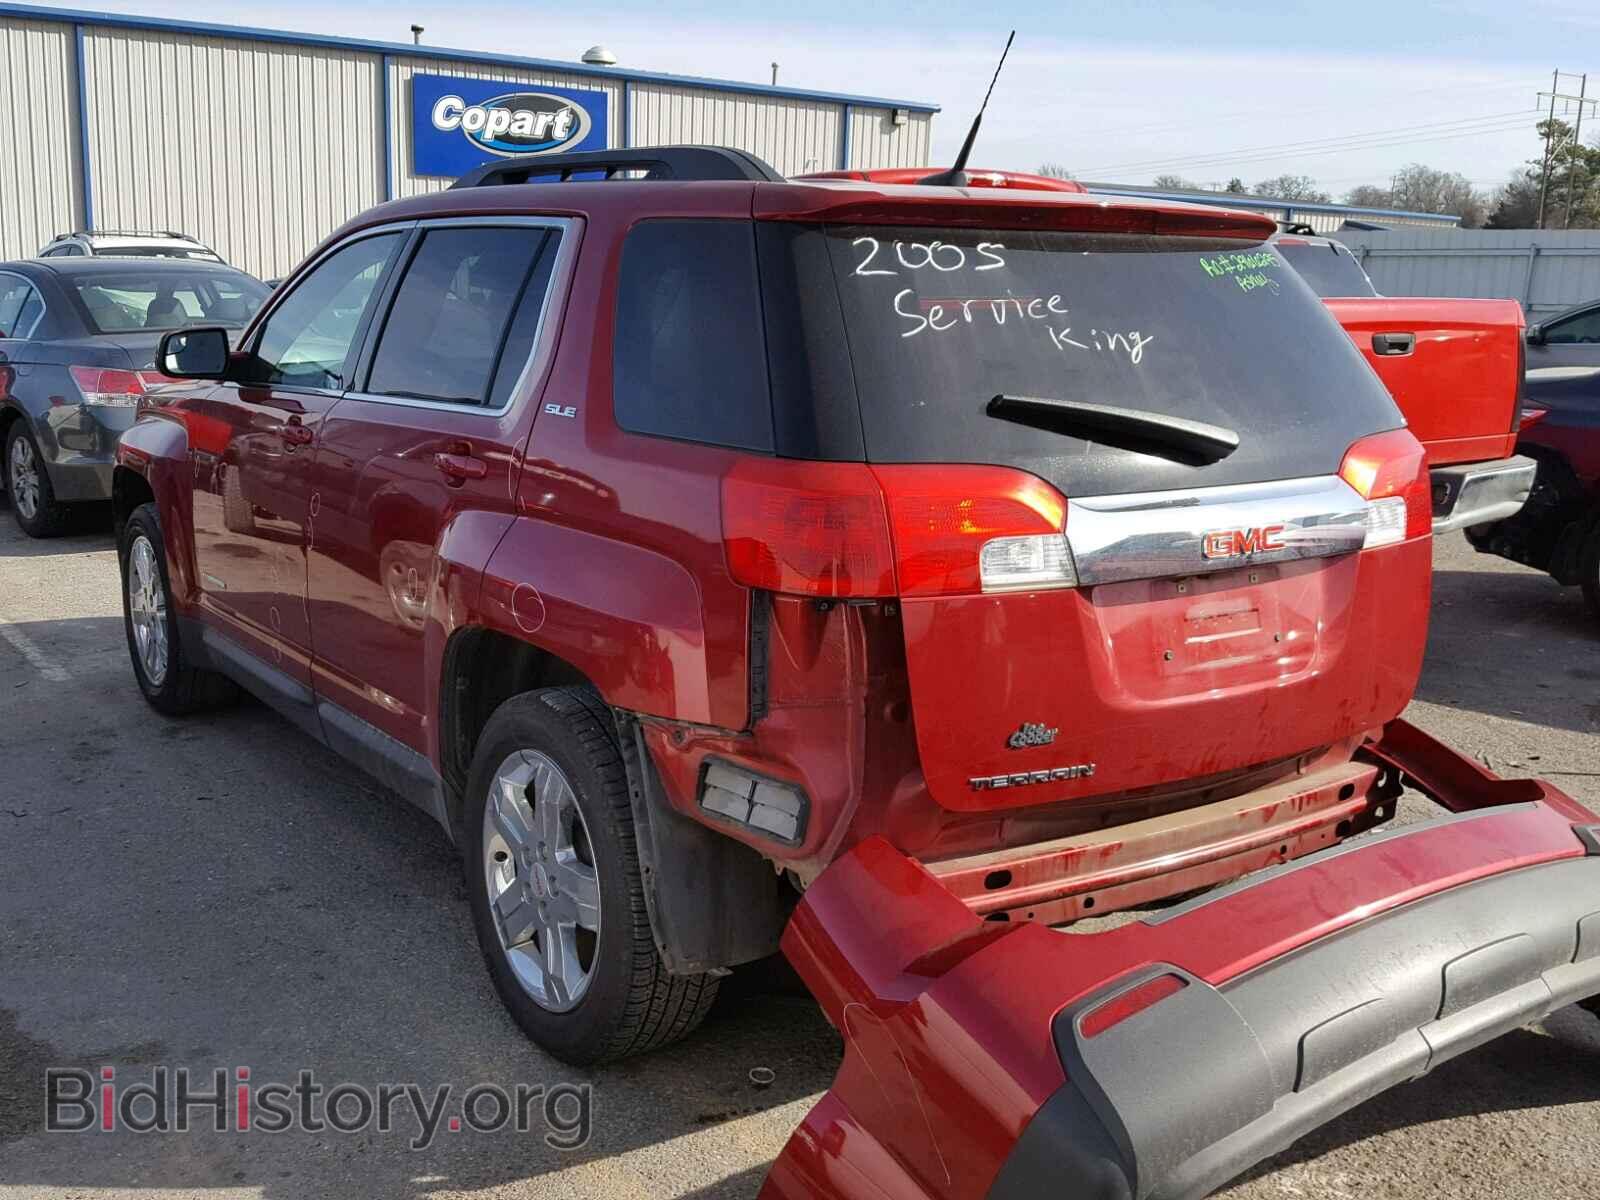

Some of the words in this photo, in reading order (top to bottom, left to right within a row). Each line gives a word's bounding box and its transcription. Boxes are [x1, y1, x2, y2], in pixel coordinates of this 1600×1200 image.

[432, 95, 573, 141] Copart
[894, 289, 1069, 338] Service
[1047, 326, 1154, 364] King
[544, 403, 577, 418] SLE
[1201, 524, 1286, 560] GMC
[969, 763, 1096, 790] TERRAIN
